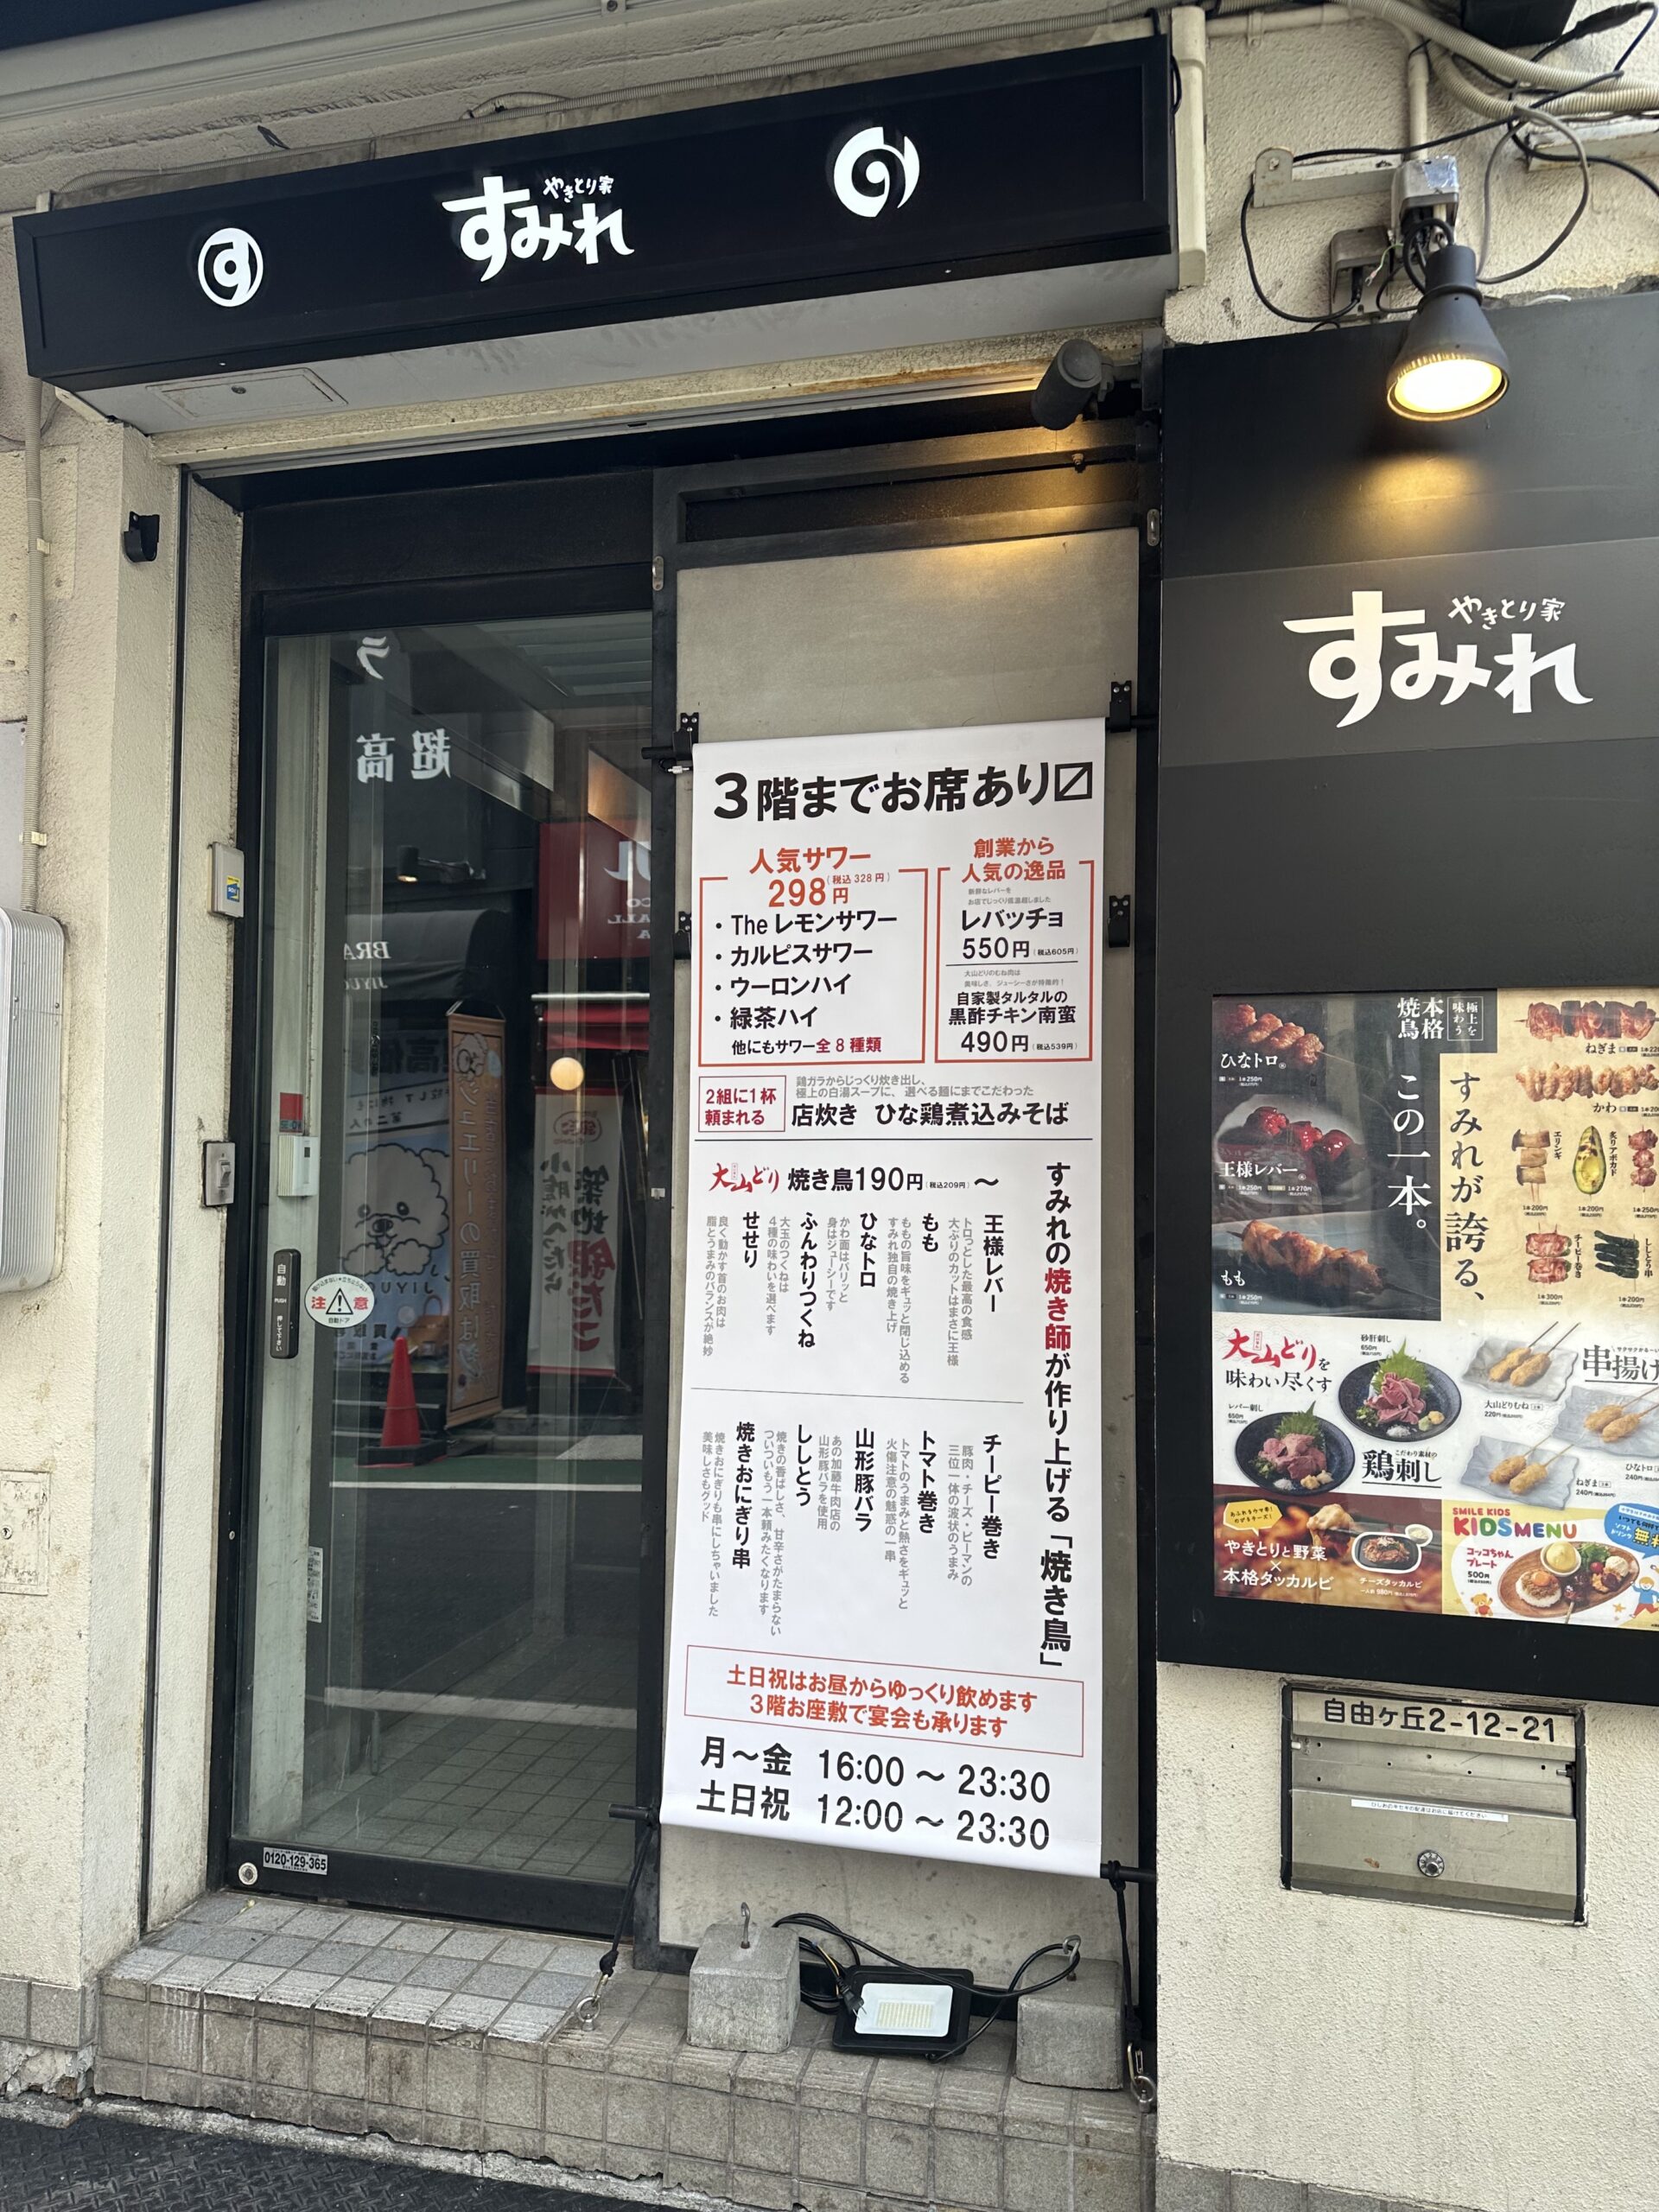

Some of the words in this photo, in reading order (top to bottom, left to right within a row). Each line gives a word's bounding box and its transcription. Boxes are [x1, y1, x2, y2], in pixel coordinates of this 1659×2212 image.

[543, 175, 614, 202] やきとり家
[442, 175, 635, 282] すみれ
[1447, 595, 1565, 630] やきとり家
[1283, 590, 1593, 728] すみれ
[749, 845, 871, 874] 人気サワー
[974, 836, 1054, 858] 創業から
[961, 860, 1065, 883] 人気の逸品
[767, 877, 849, 907] 298円
[731, 915, 767, 935] The
[776, 910, 897, 934] レモンサワー
[962, 907, 1063, 931] レバッチョ
[731, 942, 873, 967] カルピスサワー
[963, 938, 1030, 959] 550円
[731, 974, 851, 997] ウーロンハイ
[957, 991, 1067, 1006] 自家製タルタルの
[730, 1006, 818, 1029] 緑茶ハイ
[949, 1005, 1076, 1025] 黒酢チキン南蛮
[1397, 997, 1420, 1039] 焼鳥
[1421, 997, 1445, 1039] 本格
[1452, 1002, 1465, 1035] 味わう
[1466, 1002, 1478, 1036] 極上を
[961, 1031, 1028, 1052] 490円
[1586, 1043, 1616, 1054] ねぎま
[1220, 1052, 1278, 1068] ひなトロ
[706, 1088, 776, 1105] 2組に1杯
[795, 1075, 925, 1087] 鶏ガラからじっくり炊き出し、
[795, 1084, 895, 1098] 極上の白湯スープに、
[705, 1109, 765, 1126] 頼まれる
[791, 1103, 857, 1126] 店炊き
[875, 1102, 1069, 1126] ひな鶏煮込みそば
[1592, 1103, 1617, 1113] かわ
[1387, 1074, 1432, 1229] この一本。
[1554, 1131, 1562, 1160] エリンギ
[709, 1162, 779, 1193] 大山どり
[787, 1166, 923, 1192] 焼き鳥190円
[1218, 1160, 1298, 1178] 王様レバー
[1445, 1071, 1489, 1300] すみれが誇る、
[742, 1211, 760, 1268] せせり
[922, 1213, 938, 1252] もも
[779, 1217, 791, 1293] 大玉のつくねは
[826, 1217, 837, 1312] 身はジューシーです
[860, 1212, 877, 1287] ひなトロ
[983, 1214, 1004, 1312] 王様レバー
[276, 1264, 287, 1287] 自動
[702, 1216, 717, 1357] 脂とうまみのバランスが絶妙
[716, 1216, 728, 1328] 良く動かす首のお肉は
[766, 1217, 778, 1336] 4種の味わいを選べます
[798, 1212, 817, 1348] ふんわりつくね
[887, 1217, 899, 1333] すみれ独自の焼き上げ
[961, 1217, 973, 1340] トロっとした最高の食感
[1221, 1270, 1245, 1286] もも
[311, 1296, 326, 1309] 注
[353, 1297, 368, 1310] 意
[899, 1217, 912, 1383] ももの旨味をギュッと閉じ込める
[947, 1217, 960, 1366] 大ぶりのカットはまさに王様
[1223, 1328, 1317, 1371] 大山どり
[1319, 1358, 1331, 1370] を
[1361, 1334, 1391, 1343] 砂肝刺し
[1226, 1369, 1332, 1393] 味わい尽くす
[1484, 1400, 1529, 1410] 大山どりむね
[702, 1431, 713, 1522] 美味しさもグッド
[796, 1424, 812, 1507] ししとう
[855, 1427, 874, 1533] 山形豚バラ
[1362, 1449, 1441, 1483] 鶏刺し
[1626, 1463, 1653, 1471] ひなトロ
[732, 1421, 755, 1569] 焼きおにぎり串
[817, 1434, 830, 1530] 山形豚バラを使用
[830, 1435, 842, 1532] あの加藤牛肉店の
[918, 1430, 938, 1534] トマト巻き
[982, 1433, 1002, 1559] チーピー巻き
[1576, 1478, 1598, 1487] ねぎま
[709, 1432, 726, 1618] 焼きおにぎりも串にしちゃいました
[1453, 1517, 1512, 1536] KIDS
[1515, 1522, 1577, 1539] MENU
[1224, 1541, 1327, 1561] やきとりと野菜
[1467, 1548, 1514, 1559] コッコちゃん
[1223, 1567, 1334, 1591] 本格タッカルビ
[727, 1664, 1038, 1712] 土日祝はお昼からゆっくり飲めます
[750, 1694, 1007, 1738] 3階お座敷で宴会も承ります
[700, 1735, 792, 1777] 月～金
[819, 1749, 905, 1787] 16:00
[958, 1764, 1051, 1802] 23:30
[696, 1779, 791, 1821] 土日祝
[817, 1794, 904, 1832] 12:00
[957, 1810, 1050, 1850] 23:30
[264, 1851, 326, 1870] 0120-129-365
